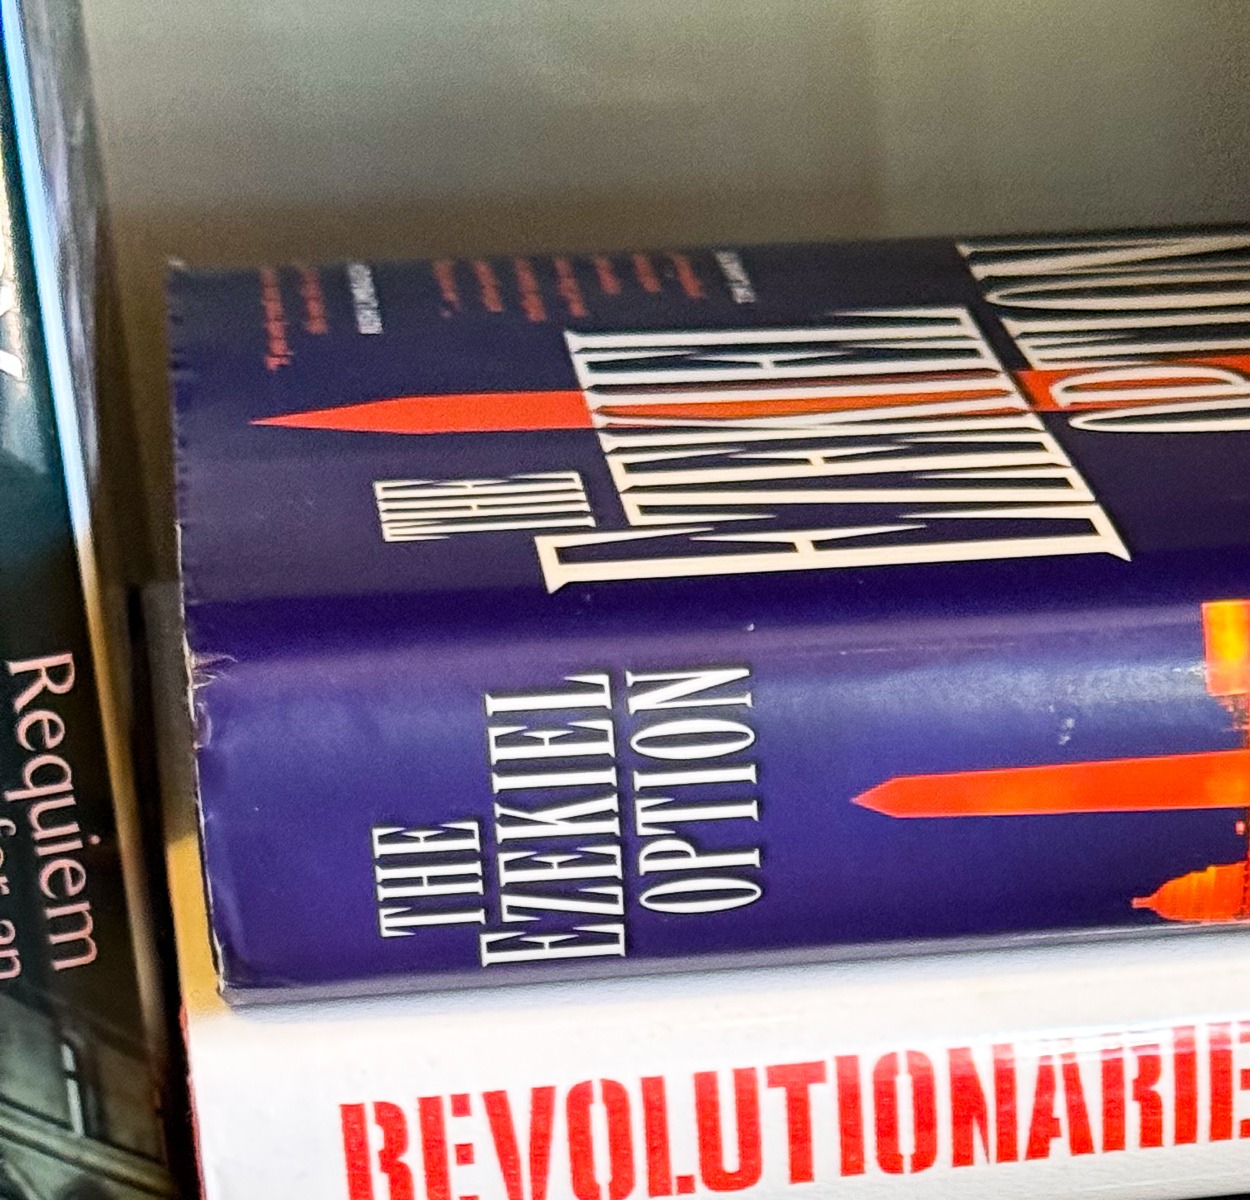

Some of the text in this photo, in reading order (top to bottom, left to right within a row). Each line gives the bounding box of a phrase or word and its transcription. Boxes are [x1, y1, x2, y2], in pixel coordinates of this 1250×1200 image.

[373, 471, 596, 542] THE
[535, 307, 1132, 593] EZEKIEL
[3, 652, 101, 971] Requiem
[372, 820, 487, 938] THE
[479, 672, 627, 968] EZEKIEL
[625, 667, 763, 914] OPTION
